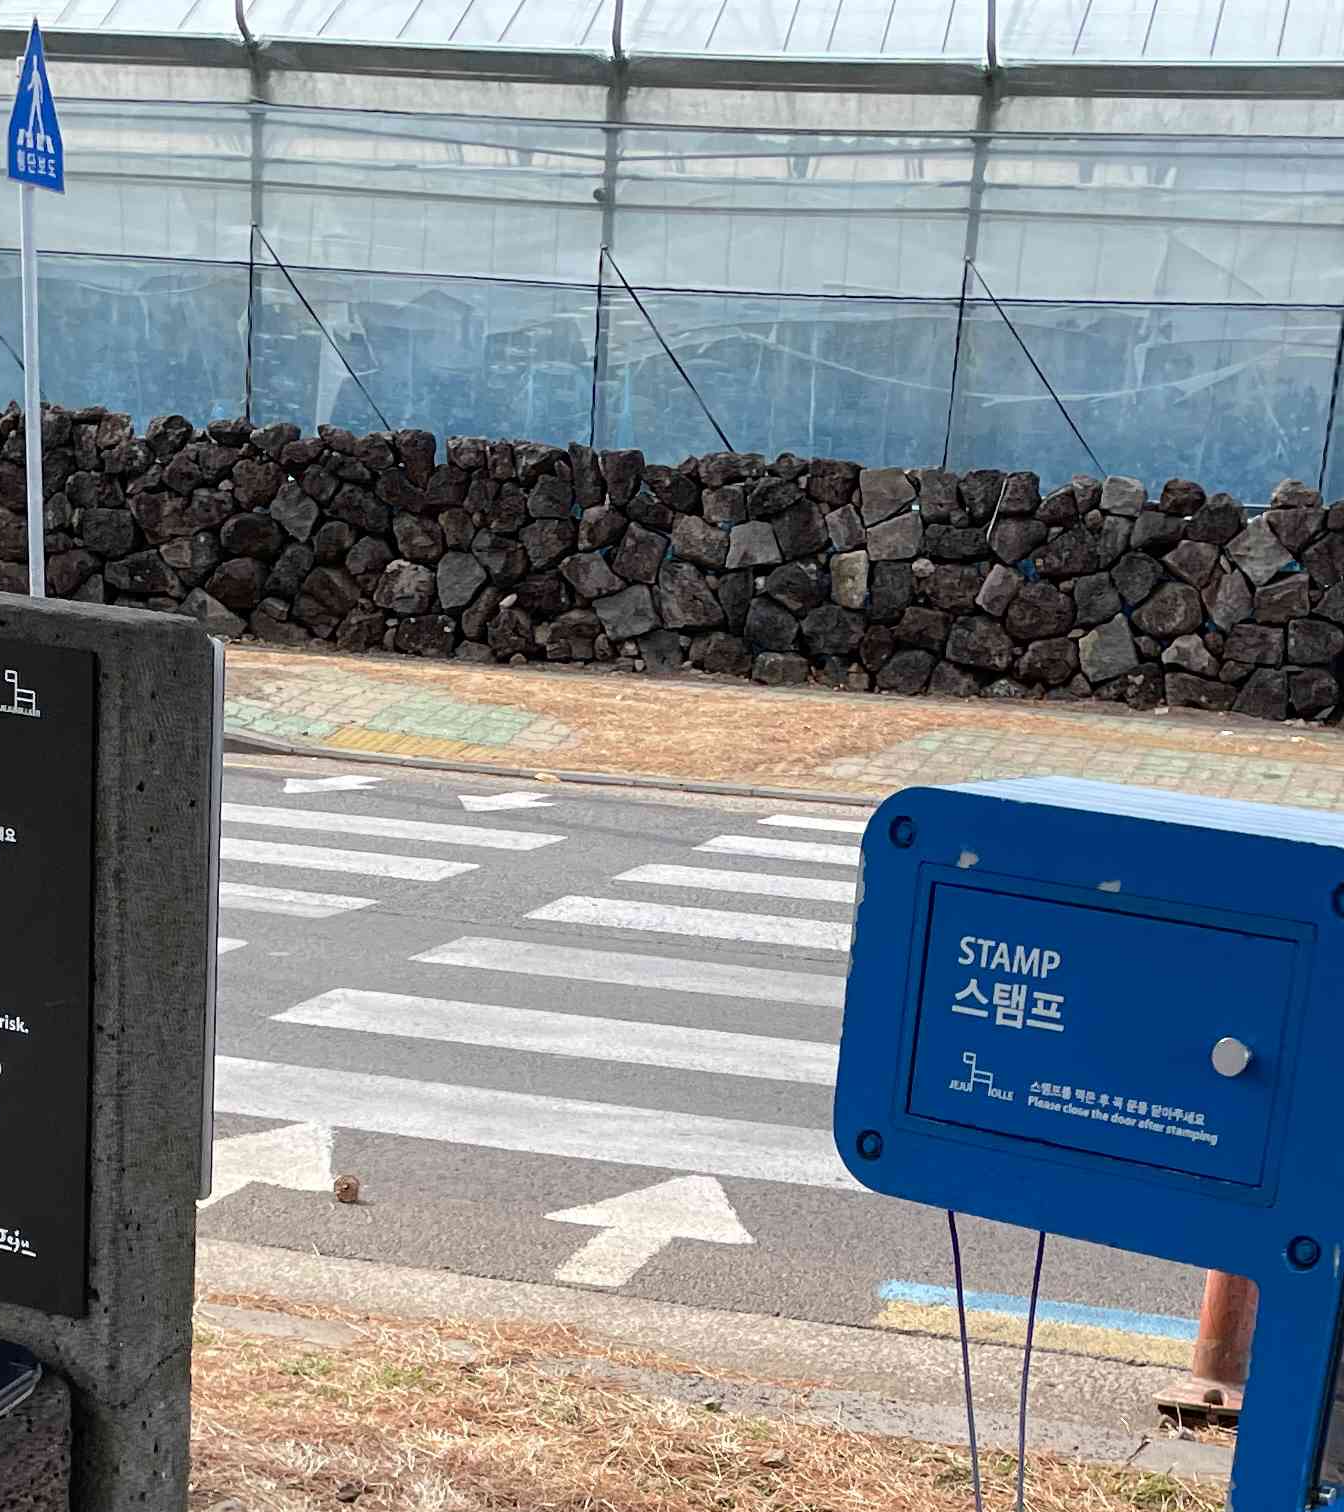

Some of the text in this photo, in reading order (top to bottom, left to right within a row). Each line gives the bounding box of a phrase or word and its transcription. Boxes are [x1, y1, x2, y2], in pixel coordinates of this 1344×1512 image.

[958, 936, 1061, 979] STAMP
[951, 978, 1065, 1032] 스탬프
[1027, 1095, 1218, 1147] Please close the door after stamping
